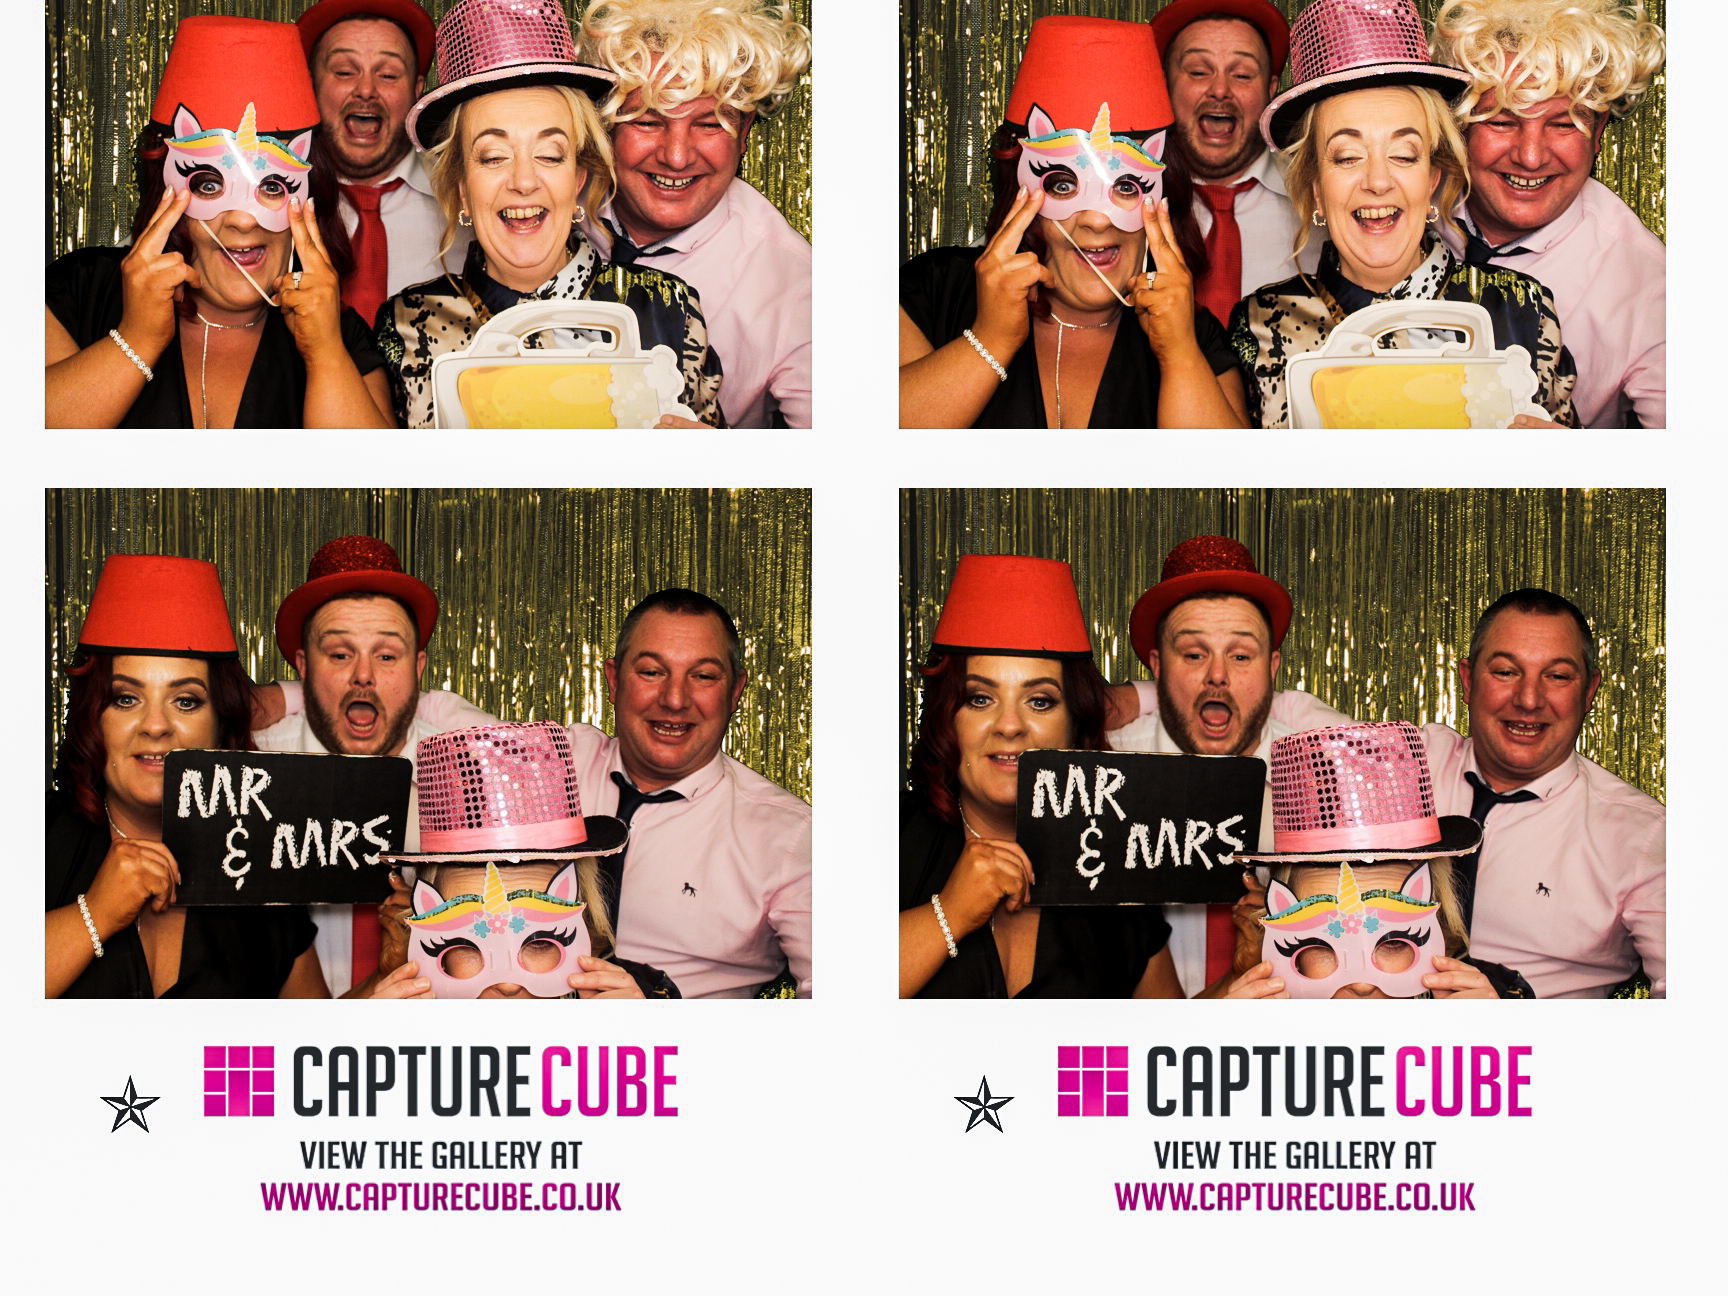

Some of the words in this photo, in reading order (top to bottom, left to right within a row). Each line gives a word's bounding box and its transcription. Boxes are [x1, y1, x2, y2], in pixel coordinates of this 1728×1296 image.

[177, 763, 273, 821] MR
[1031, 763, 1127, 821] MR
[221, 818, 252, 891] &
[270, 814, 392, 870] MRS
[1075, 818, 1106, 891] &
[1124, 814, 1246, 870] MRS
